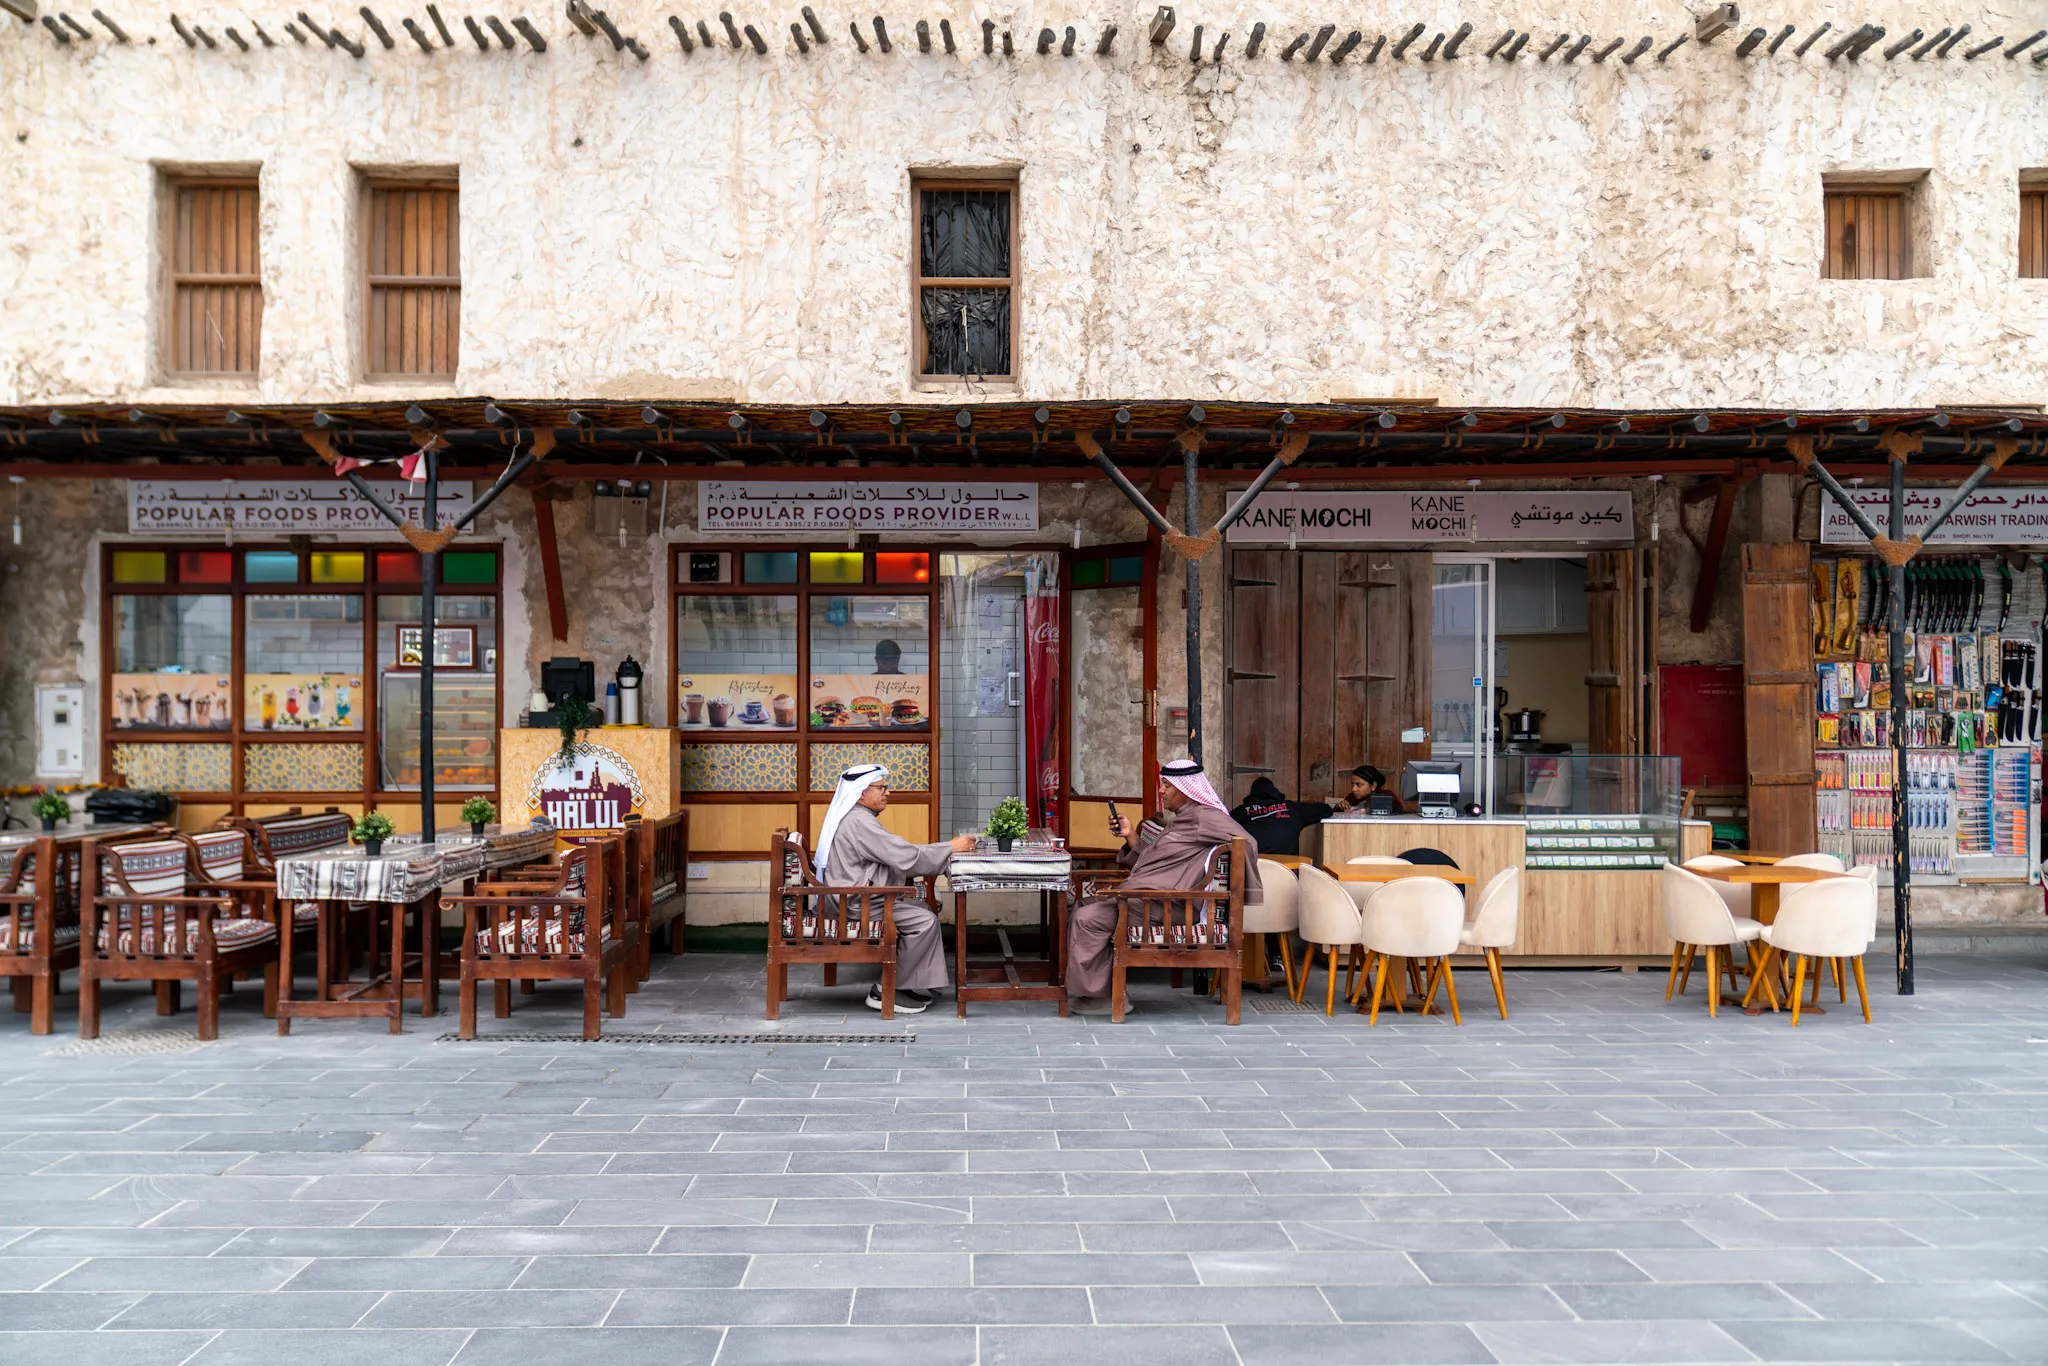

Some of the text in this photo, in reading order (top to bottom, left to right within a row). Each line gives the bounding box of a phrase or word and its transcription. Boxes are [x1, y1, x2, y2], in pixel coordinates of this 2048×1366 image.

[740, 488, 847, 504] الشعبية
[1411, 496, 1465, 511] KANE
[137, 507, 236, 520] POPULAR
[245, 507, 318, 520] FOODS
[708, 507, 804, 520] POPULAR
[815, 507, 885, 520] FOODS
[894, 507, 1000, 520] PROVIDER
[1236, 508, 1371, 527] KANE MOCHI
[1511, 504, 1622, 528] كين موتشي
[1877, 515, 1931, 525] RAMAN
[1946, 515, 1996, 525] ARWISH
[1412, 517, 1466, 530] MOCHI
[547, 800, 625, 829] HALUL
